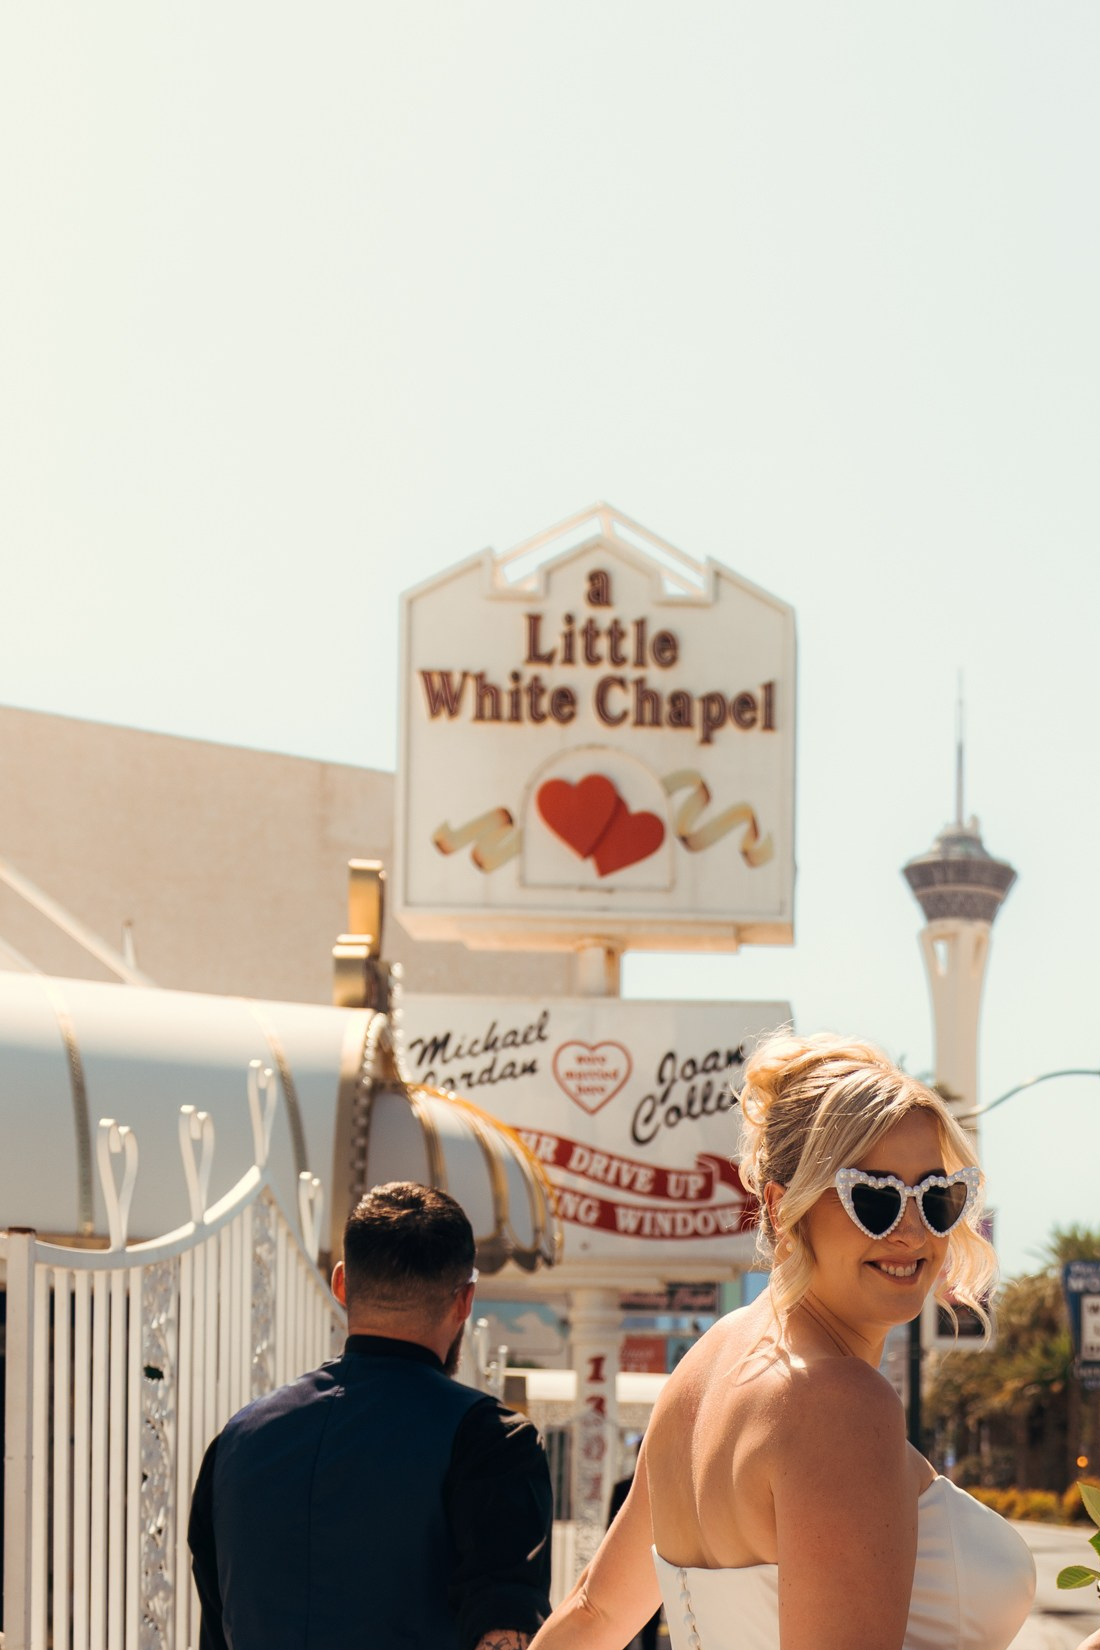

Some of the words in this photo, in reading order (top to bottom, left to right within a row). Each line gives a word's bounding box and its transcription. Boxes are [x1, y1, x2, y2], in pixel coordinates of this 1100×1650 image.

[585, 569, 612, 608] a
[525, 613, 679, 668] Little
[420, 668, 578, 725] White
[593, 675, 777, 746] Chapel
[409, 1009, 550, 1067] Michael
[565, 1067, 619, 1081] married
[576, 1084, 606, 1096] here
[656, 1044, 746, 1105] Joan
[567, 1145, 656, 1193] DRIVE
[666, 1172, 706, 1200] UP
[615, 1206, 744, 1239] WINDOW
